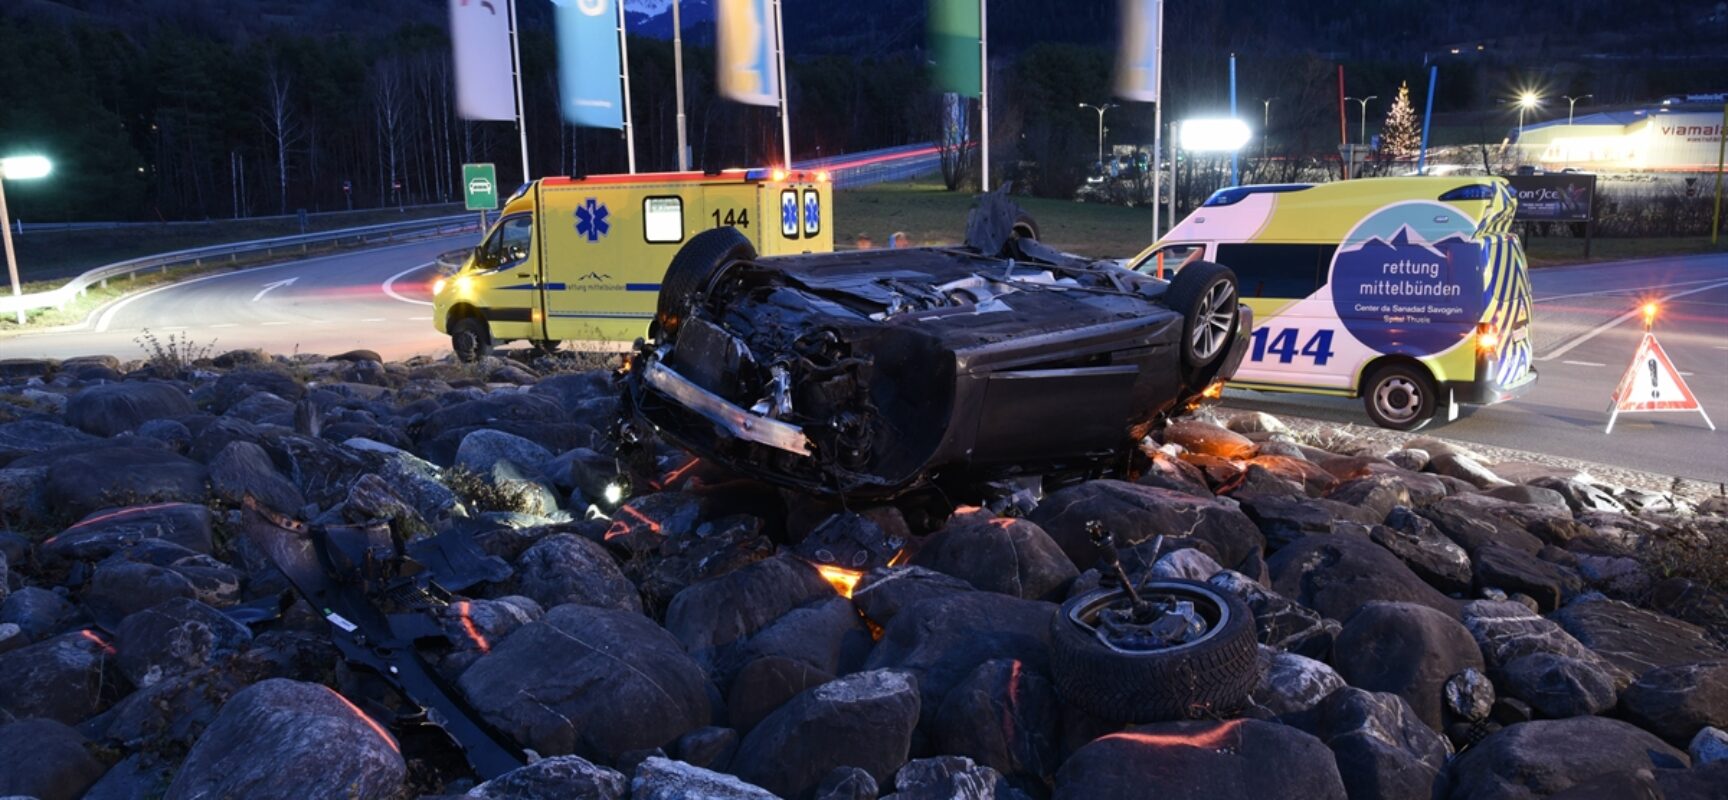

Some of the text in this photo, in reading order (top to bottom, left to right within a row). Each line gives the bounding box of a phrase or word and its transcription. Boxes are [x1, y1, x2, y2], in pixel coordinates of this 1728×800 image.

[1518, 190, 1535, 199] on
[712, 208, 749, 228] 144
[1383, 260, 1440, 278] rettung
[567, 284, 587, 293] ettung
[1359, 279, 1461, 296] mittelbünden
[1354, 303, 1463, 316] Center da Sanadad Savognin
[1406, 315, 1431, 324] Thusis
[1251, 326, 1335, 366] 144
